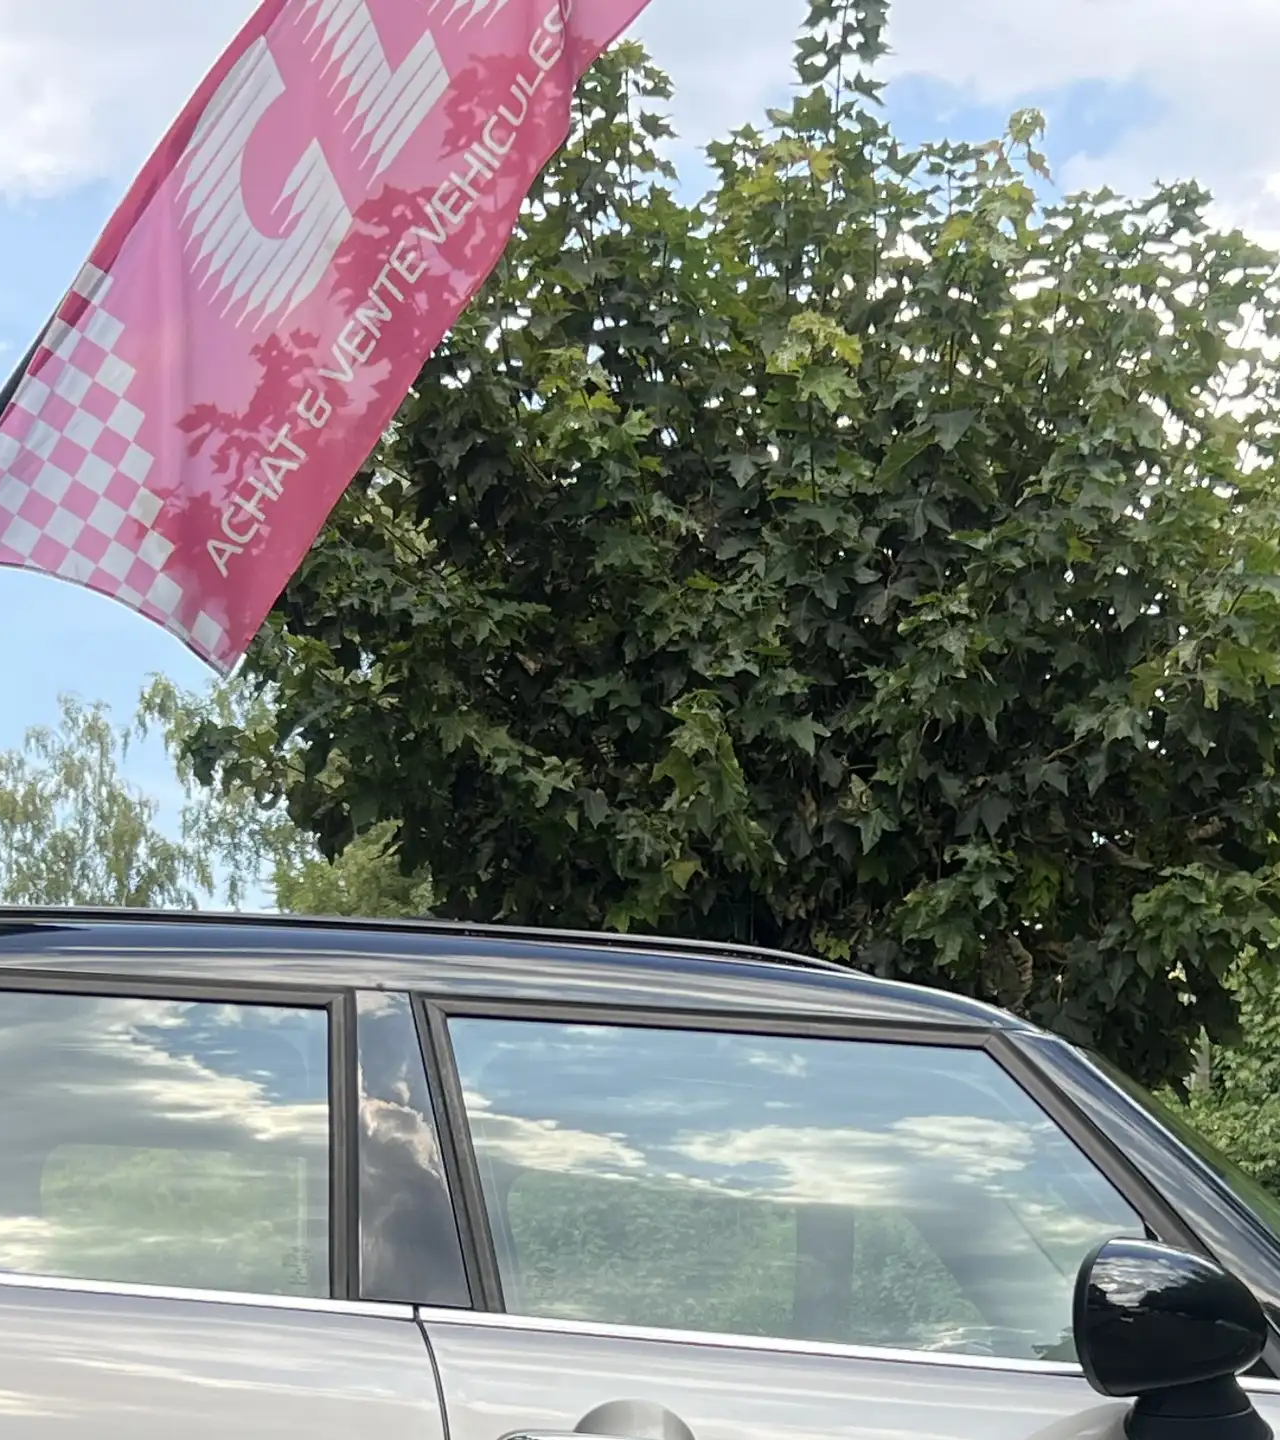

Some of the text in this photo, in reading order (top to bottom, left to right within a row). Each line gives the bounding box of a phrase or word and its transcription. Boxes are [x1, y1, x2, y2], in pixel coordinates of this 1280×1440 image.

[207, 422, 309, 578] ACHAT
[296, 388, 333, 429] &
[318, 240, 427, 382] VENTE
